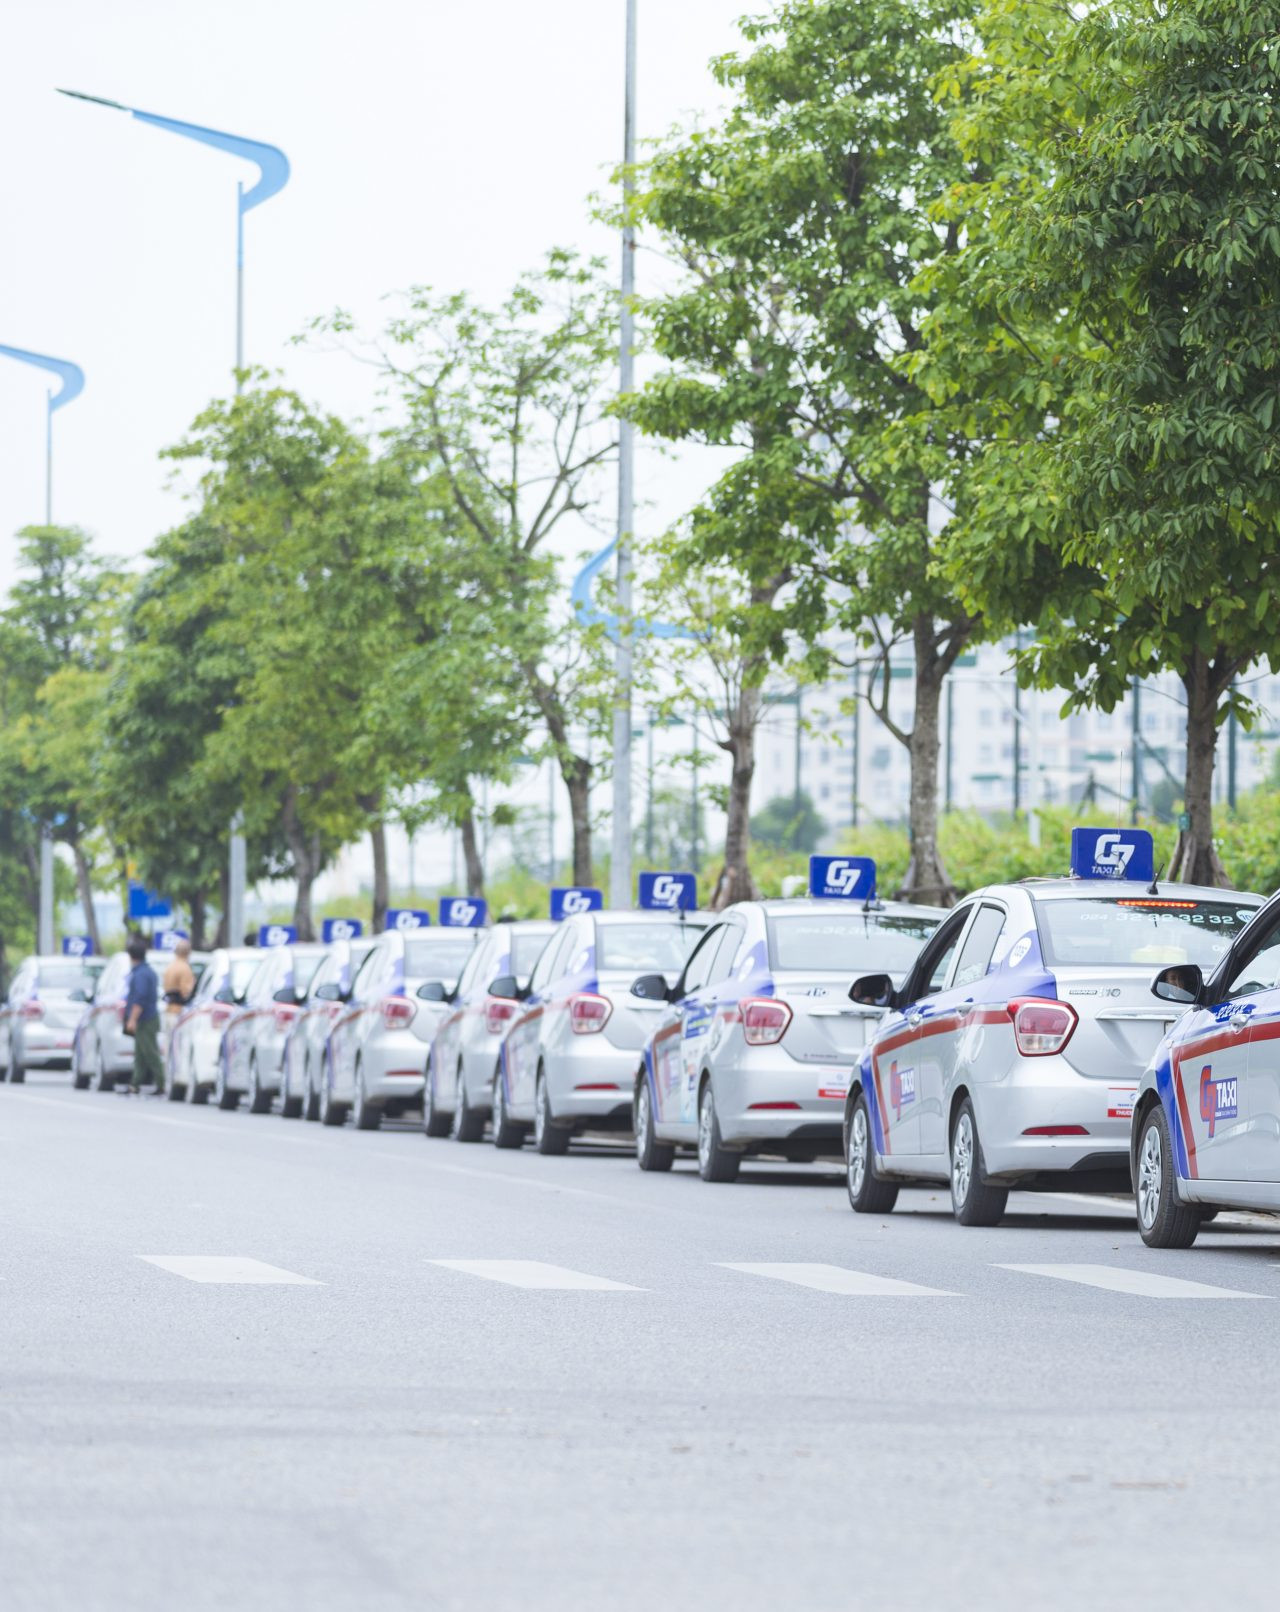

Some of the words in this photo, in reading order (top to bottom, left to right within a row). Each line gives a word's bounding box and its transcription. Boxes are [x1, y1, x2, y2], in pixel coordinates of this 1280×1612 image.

[1091, 866, 1113, 875] TAXI
[1094, 834, 1136, 876] G7
[653, 876, 684, 907] G7
[826, 860, 862, 895] G7
[450, 900, 477, 927] G7
[1178, 914, 1205, 924] 32
[1208, 915, 1236, 925] 32
[1200, 1065, 1217, 1138] G7
[1215, 1080, 1237, 1108] TAXI
